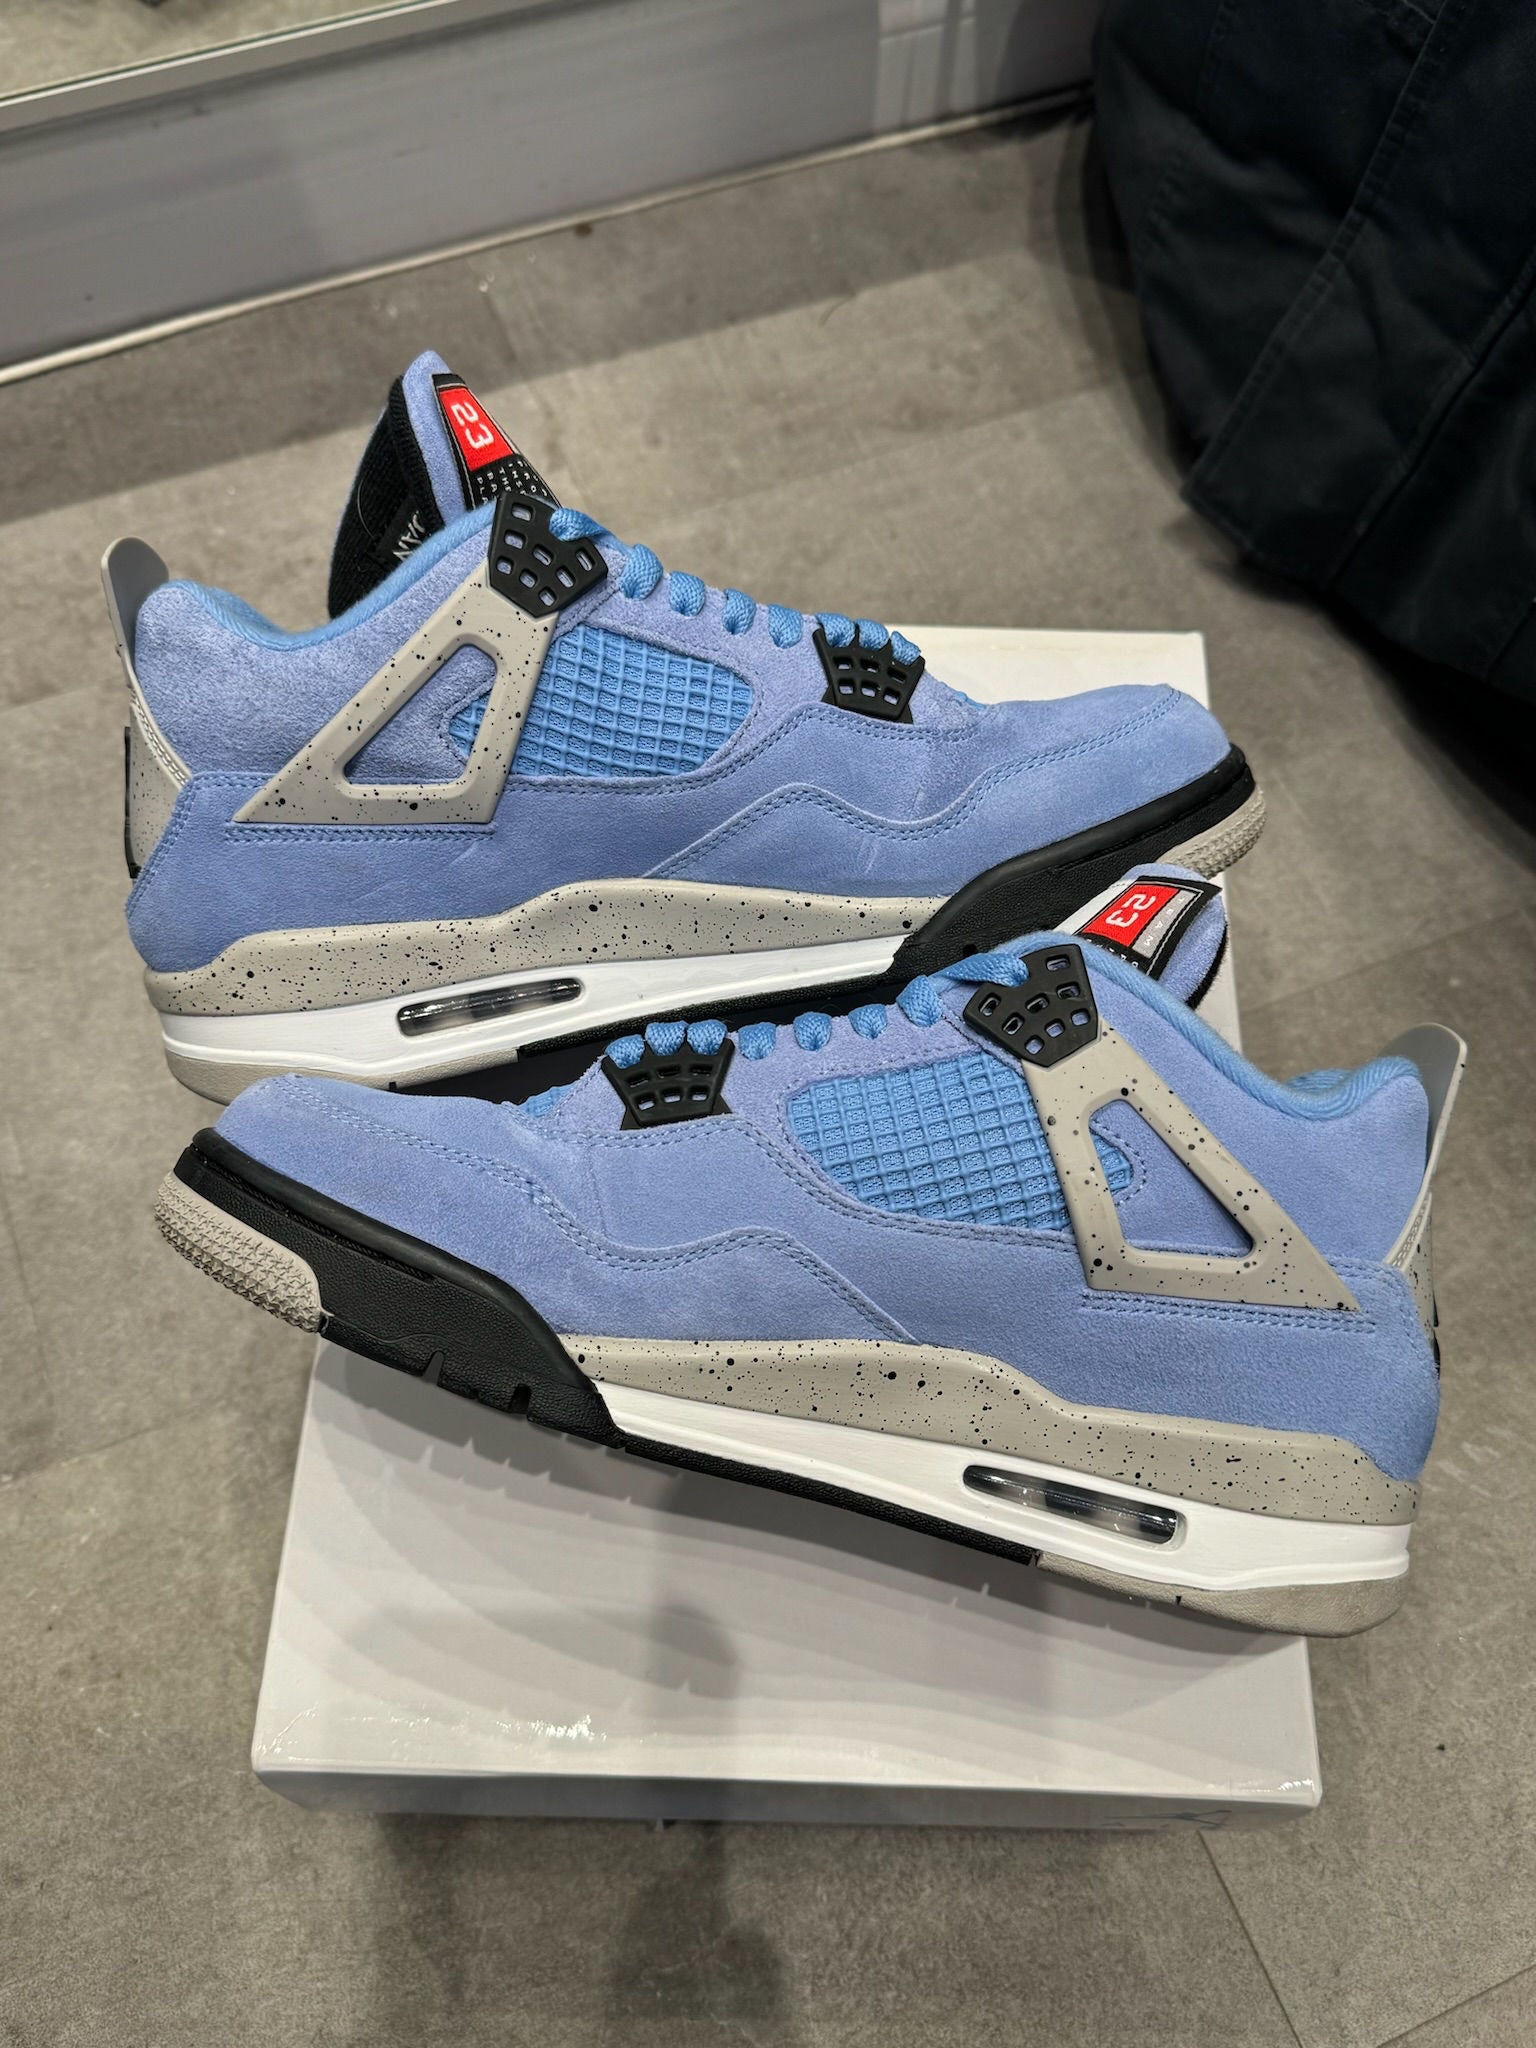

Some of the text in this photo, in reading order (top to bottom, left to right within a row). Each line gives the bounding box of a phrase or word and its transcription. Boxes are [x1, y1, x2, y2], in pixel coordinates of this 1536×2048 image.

[450, 402, 494, 449] 23
[1105, 893, 1156, 928] 23
[1144, 897, 1184, 946] TEAM
